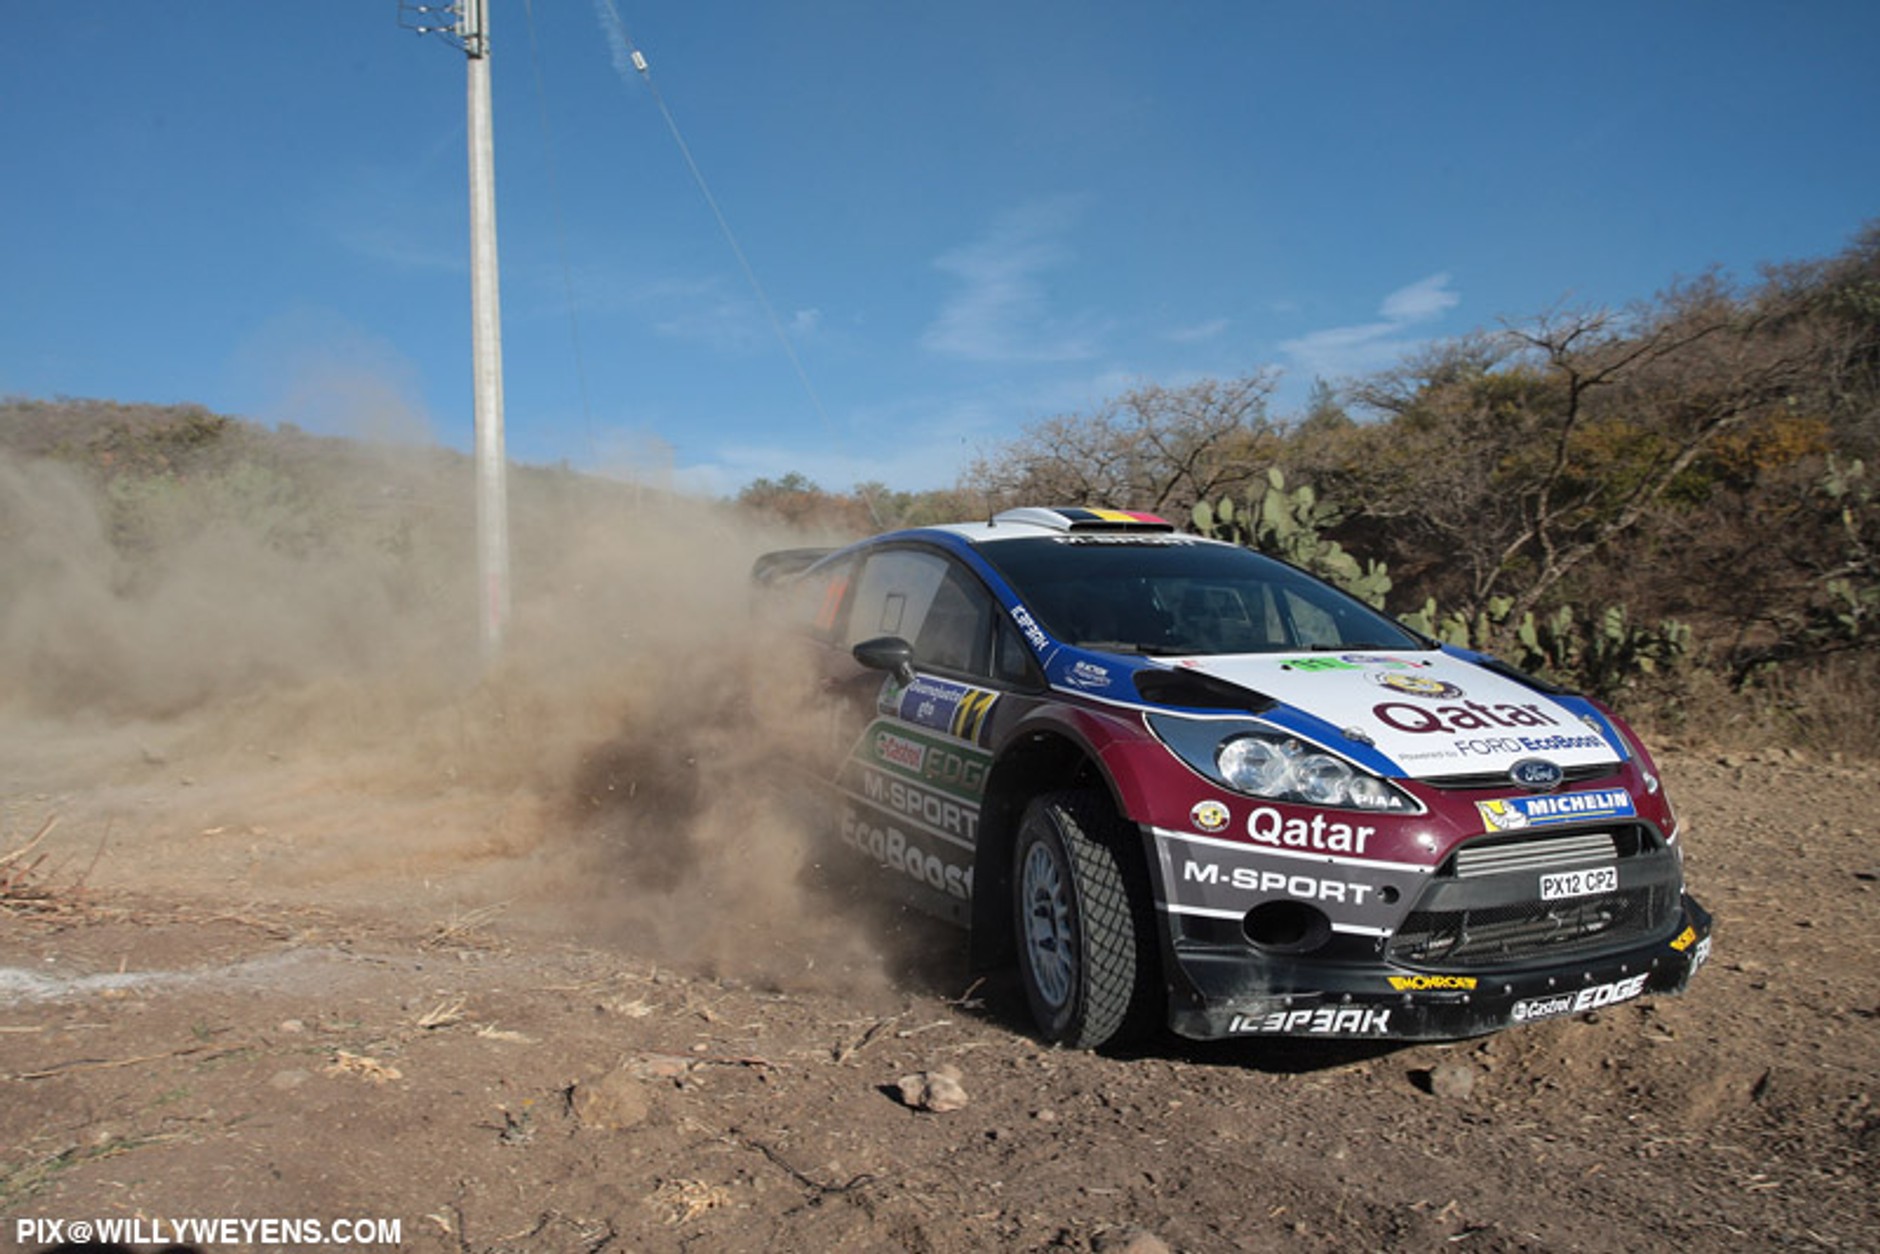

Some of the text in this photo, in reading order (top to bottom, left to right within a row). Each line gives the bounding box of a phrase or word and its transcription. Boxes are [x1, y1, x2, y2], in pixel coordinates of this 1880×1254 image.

[954, 689, 996, 744] 11
[1373, 700, 1559, 734] Qatar
[1455, 737, 1522, 757] FORD
[1518, 734, 1606, 751] EcoBoost
[1523, 763, 1555, 782] Ford
[1354, 795, 1403, 808] PIAA
[1526, 792, 1629, 816] MICHELIN
[1247, 807, 1376, 854] Qatar
[1183, 859, 1373, 905] M-SPORT
[1543, 870, 1615, 896] PX12 CPZ
[1573, 972, 1651, 1012] EDGE
